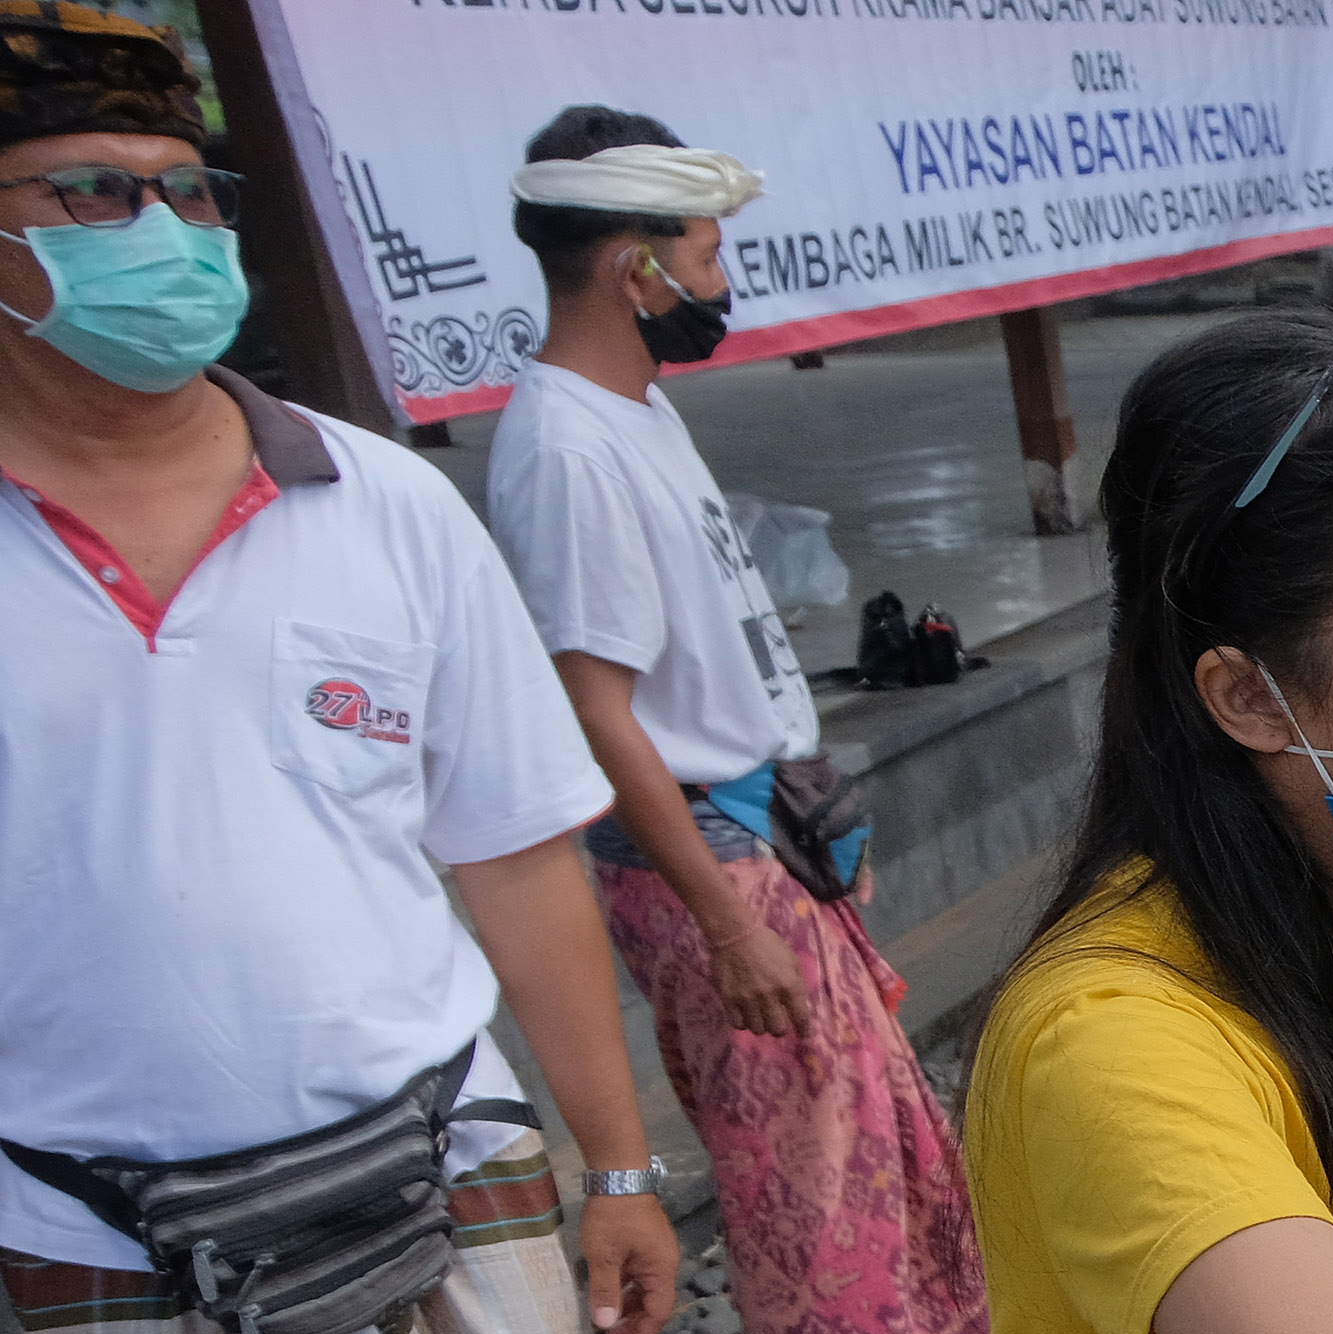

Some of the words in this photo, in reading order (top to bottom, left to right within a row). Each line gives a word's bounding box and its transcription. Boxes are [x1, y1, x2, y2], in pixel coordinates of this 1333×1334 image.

[1070, 48, 1125, 92] OLEH
[877, 112, 1064, 195] YAYASAN
[1064, 106, 1183, 176] BATAN
[1182, 100, 1288, 165] KENDAL
[729, 222, 900, 300] LEMBAGA
[902, 211, 994, 273] MILIK
[991, 207, 1042, 258] BR.
[1043, 192, 1159, 250] SUWUNG
[1160, 180, 1234, 232] BATAN
[359, 703, 411, 730] LPD
